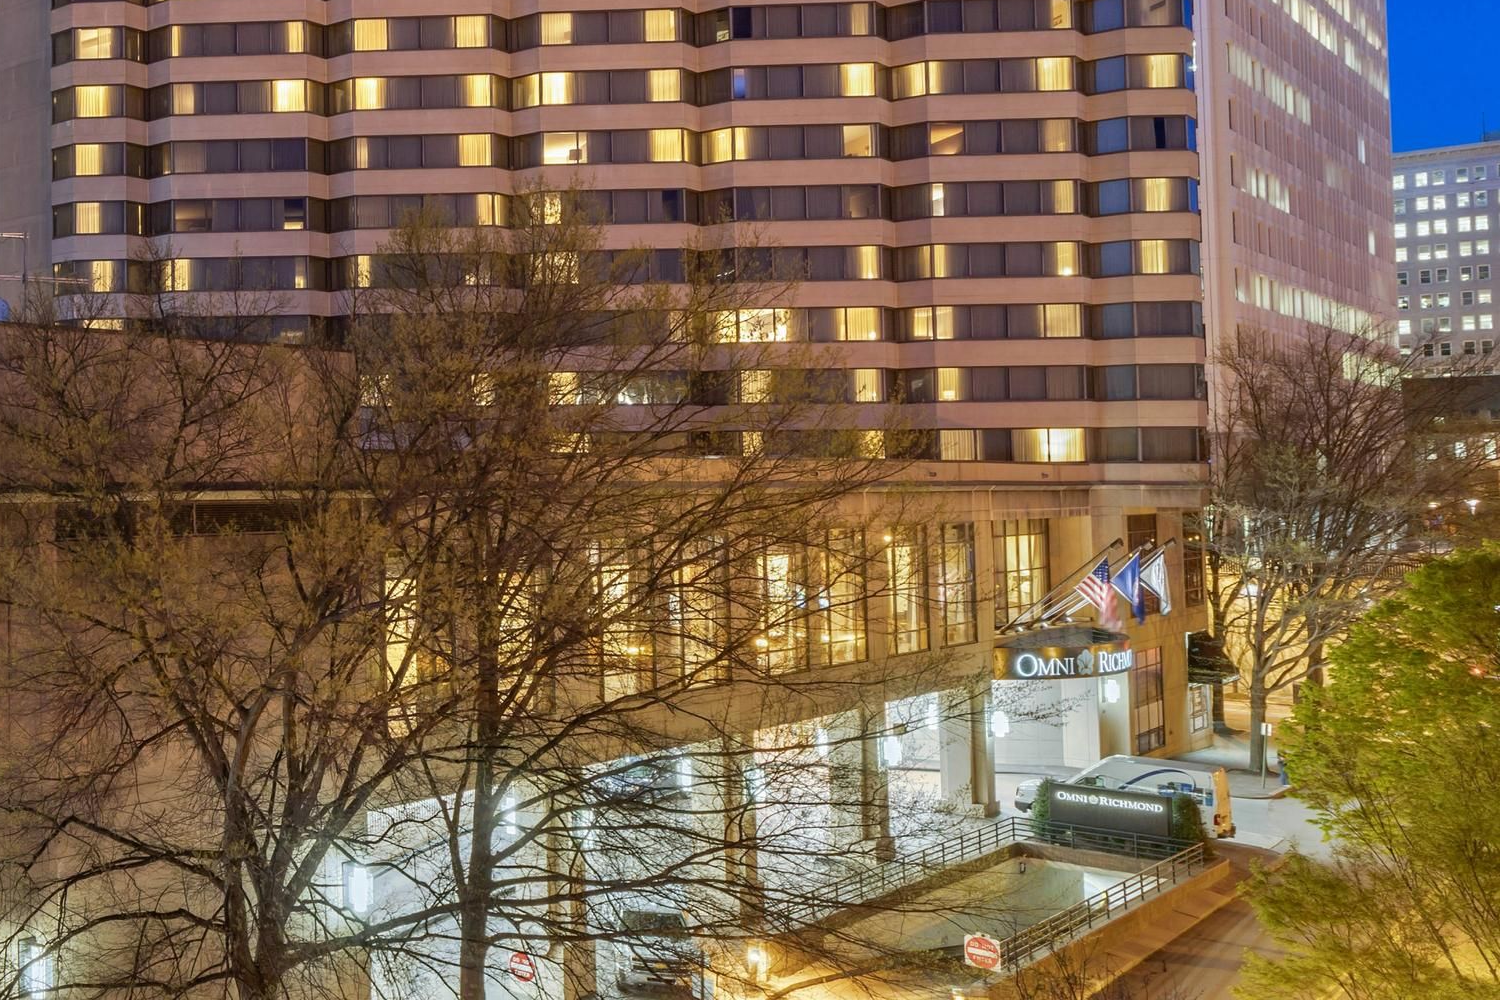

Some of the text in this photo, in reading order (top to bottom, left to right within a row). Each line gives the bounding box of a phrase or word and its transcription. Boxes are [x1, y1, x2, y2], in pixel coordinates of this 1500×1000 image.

[1016, 653, 1076, 678] OMNI
[1056, 791, 1164, 813] OMNI RICHMOND
